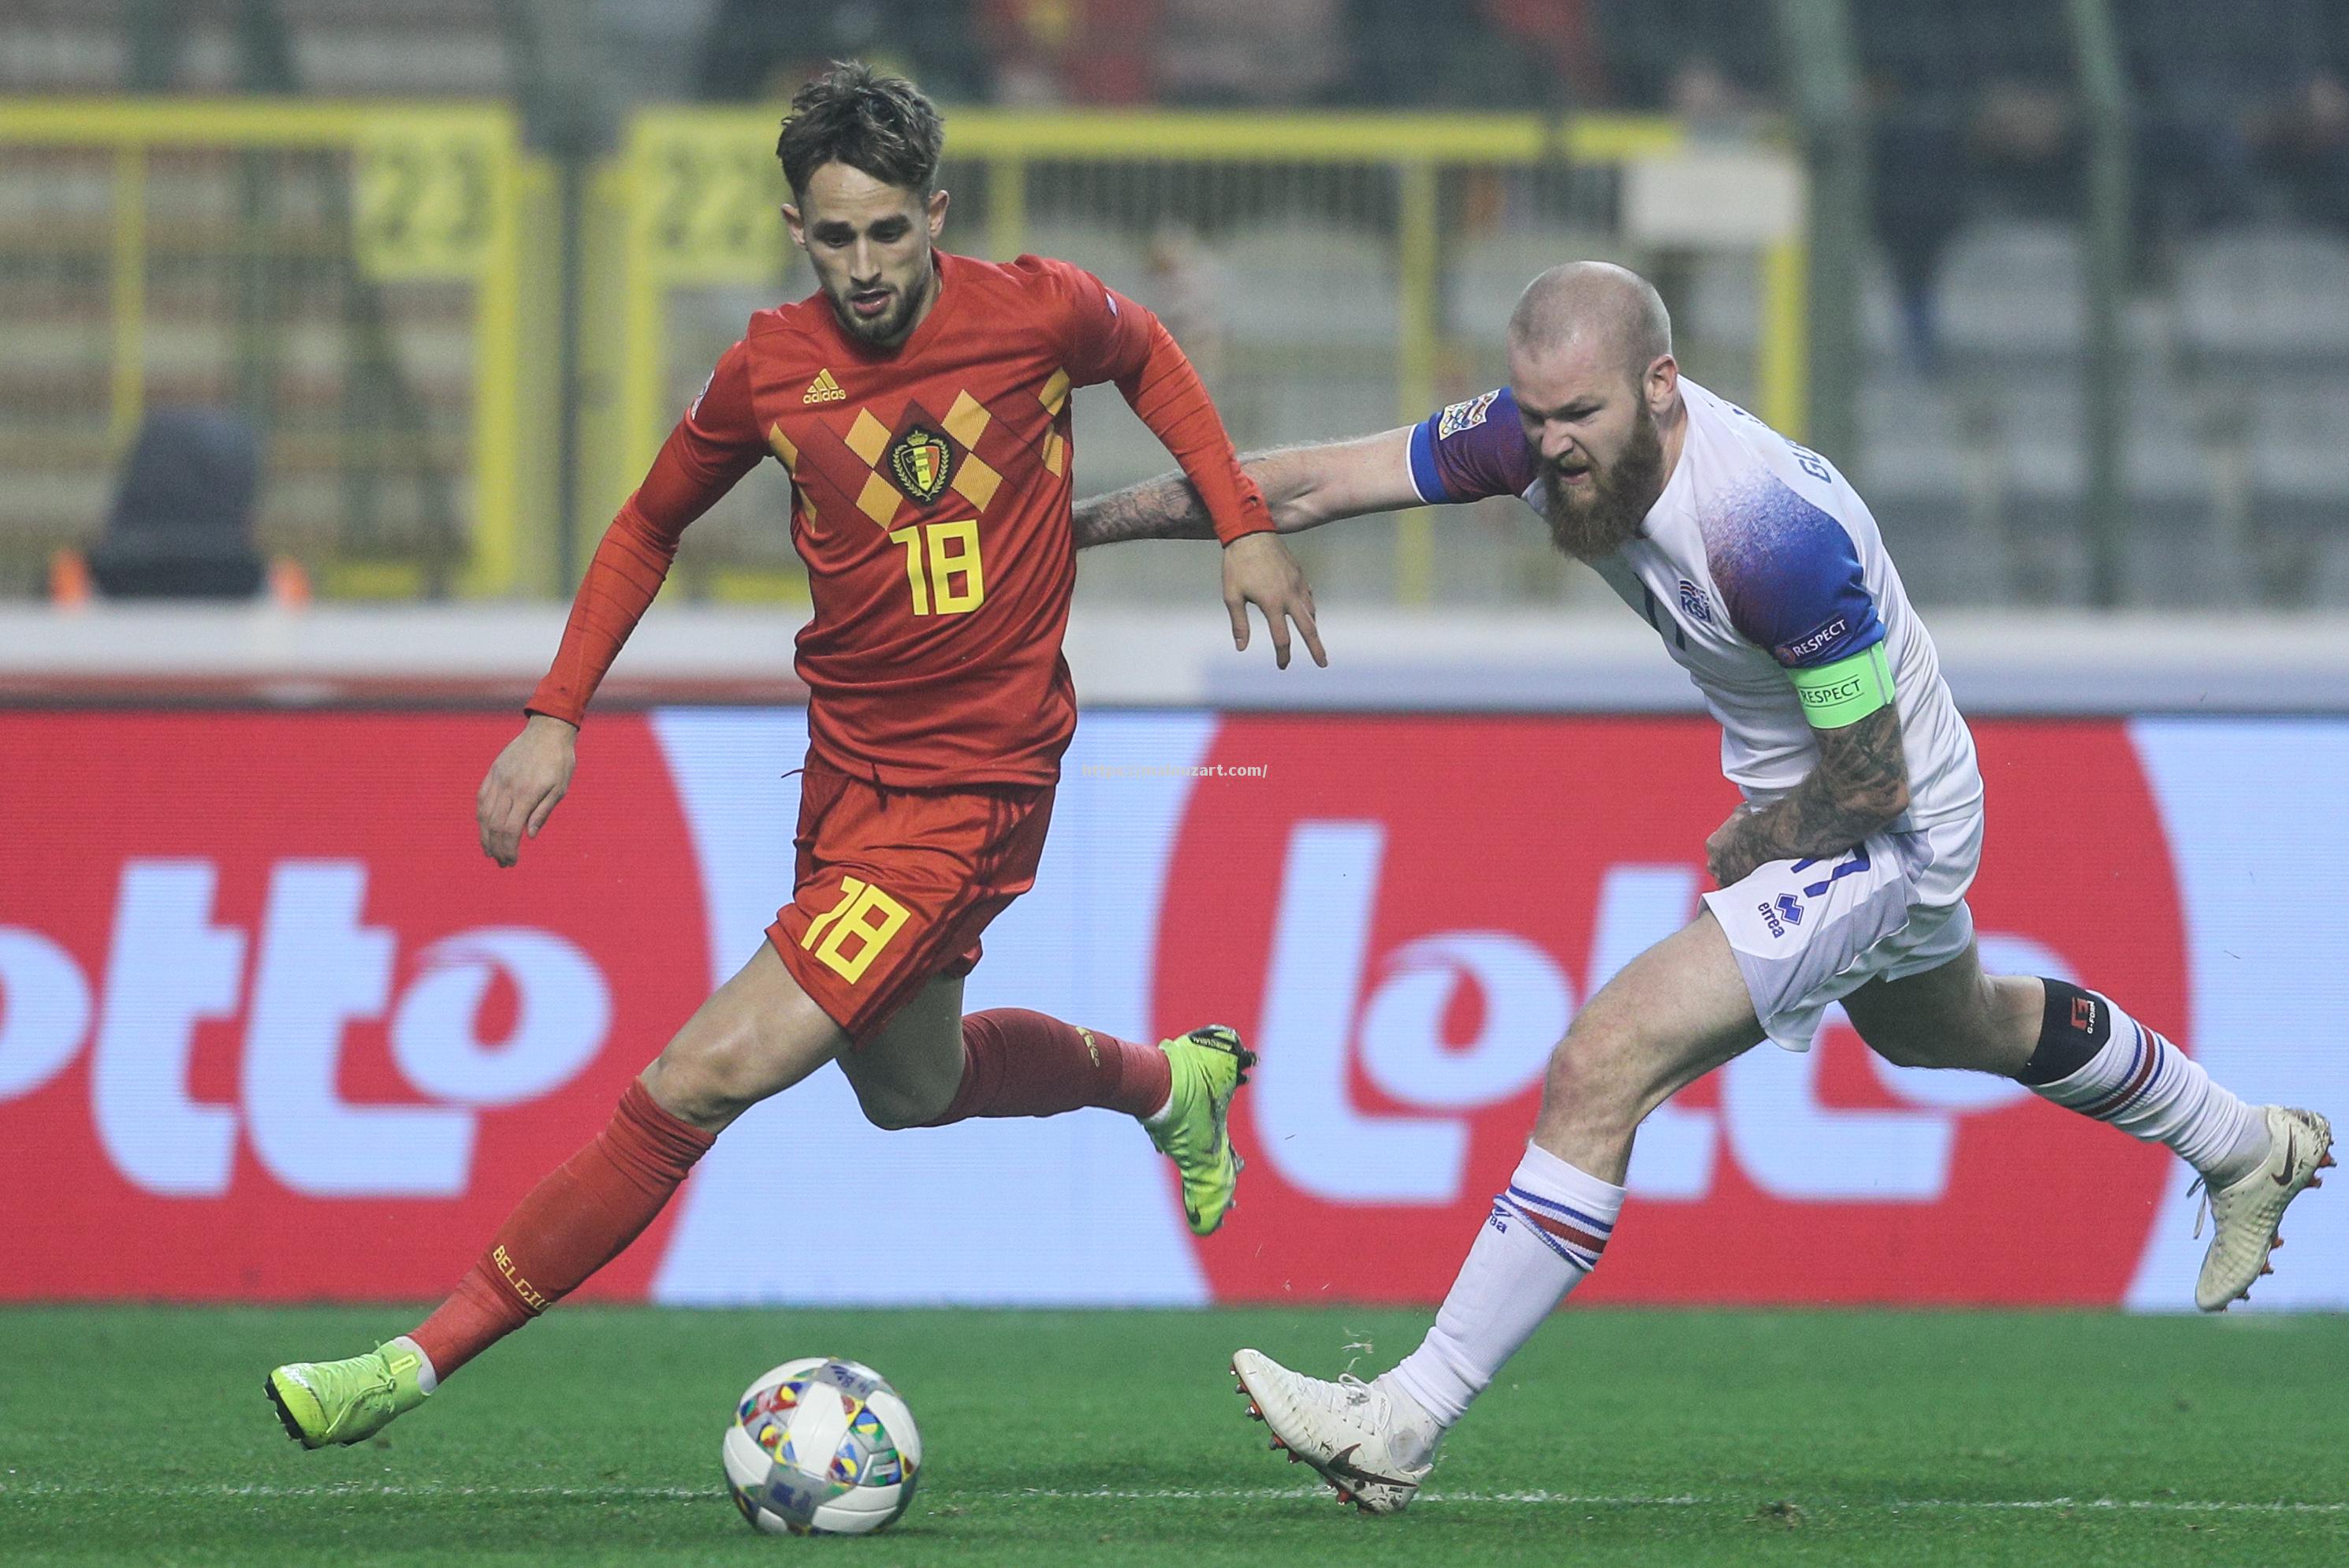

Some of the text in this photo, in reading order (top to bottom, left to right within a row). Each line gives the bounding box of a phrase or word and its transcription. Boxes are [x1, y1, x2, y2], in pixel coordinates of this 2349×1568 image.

[802, 389, 846, 404] adidas
[1785, 440, 1831, 484] GU
[888, 519, 985, 616] 18
[1792, 619, 1846, 657] RESPECT
[1800, 679, 1860, 703] RESPECT
[800, 875, 912, 985] 18
[1758, 903, 1785, 938] errea
